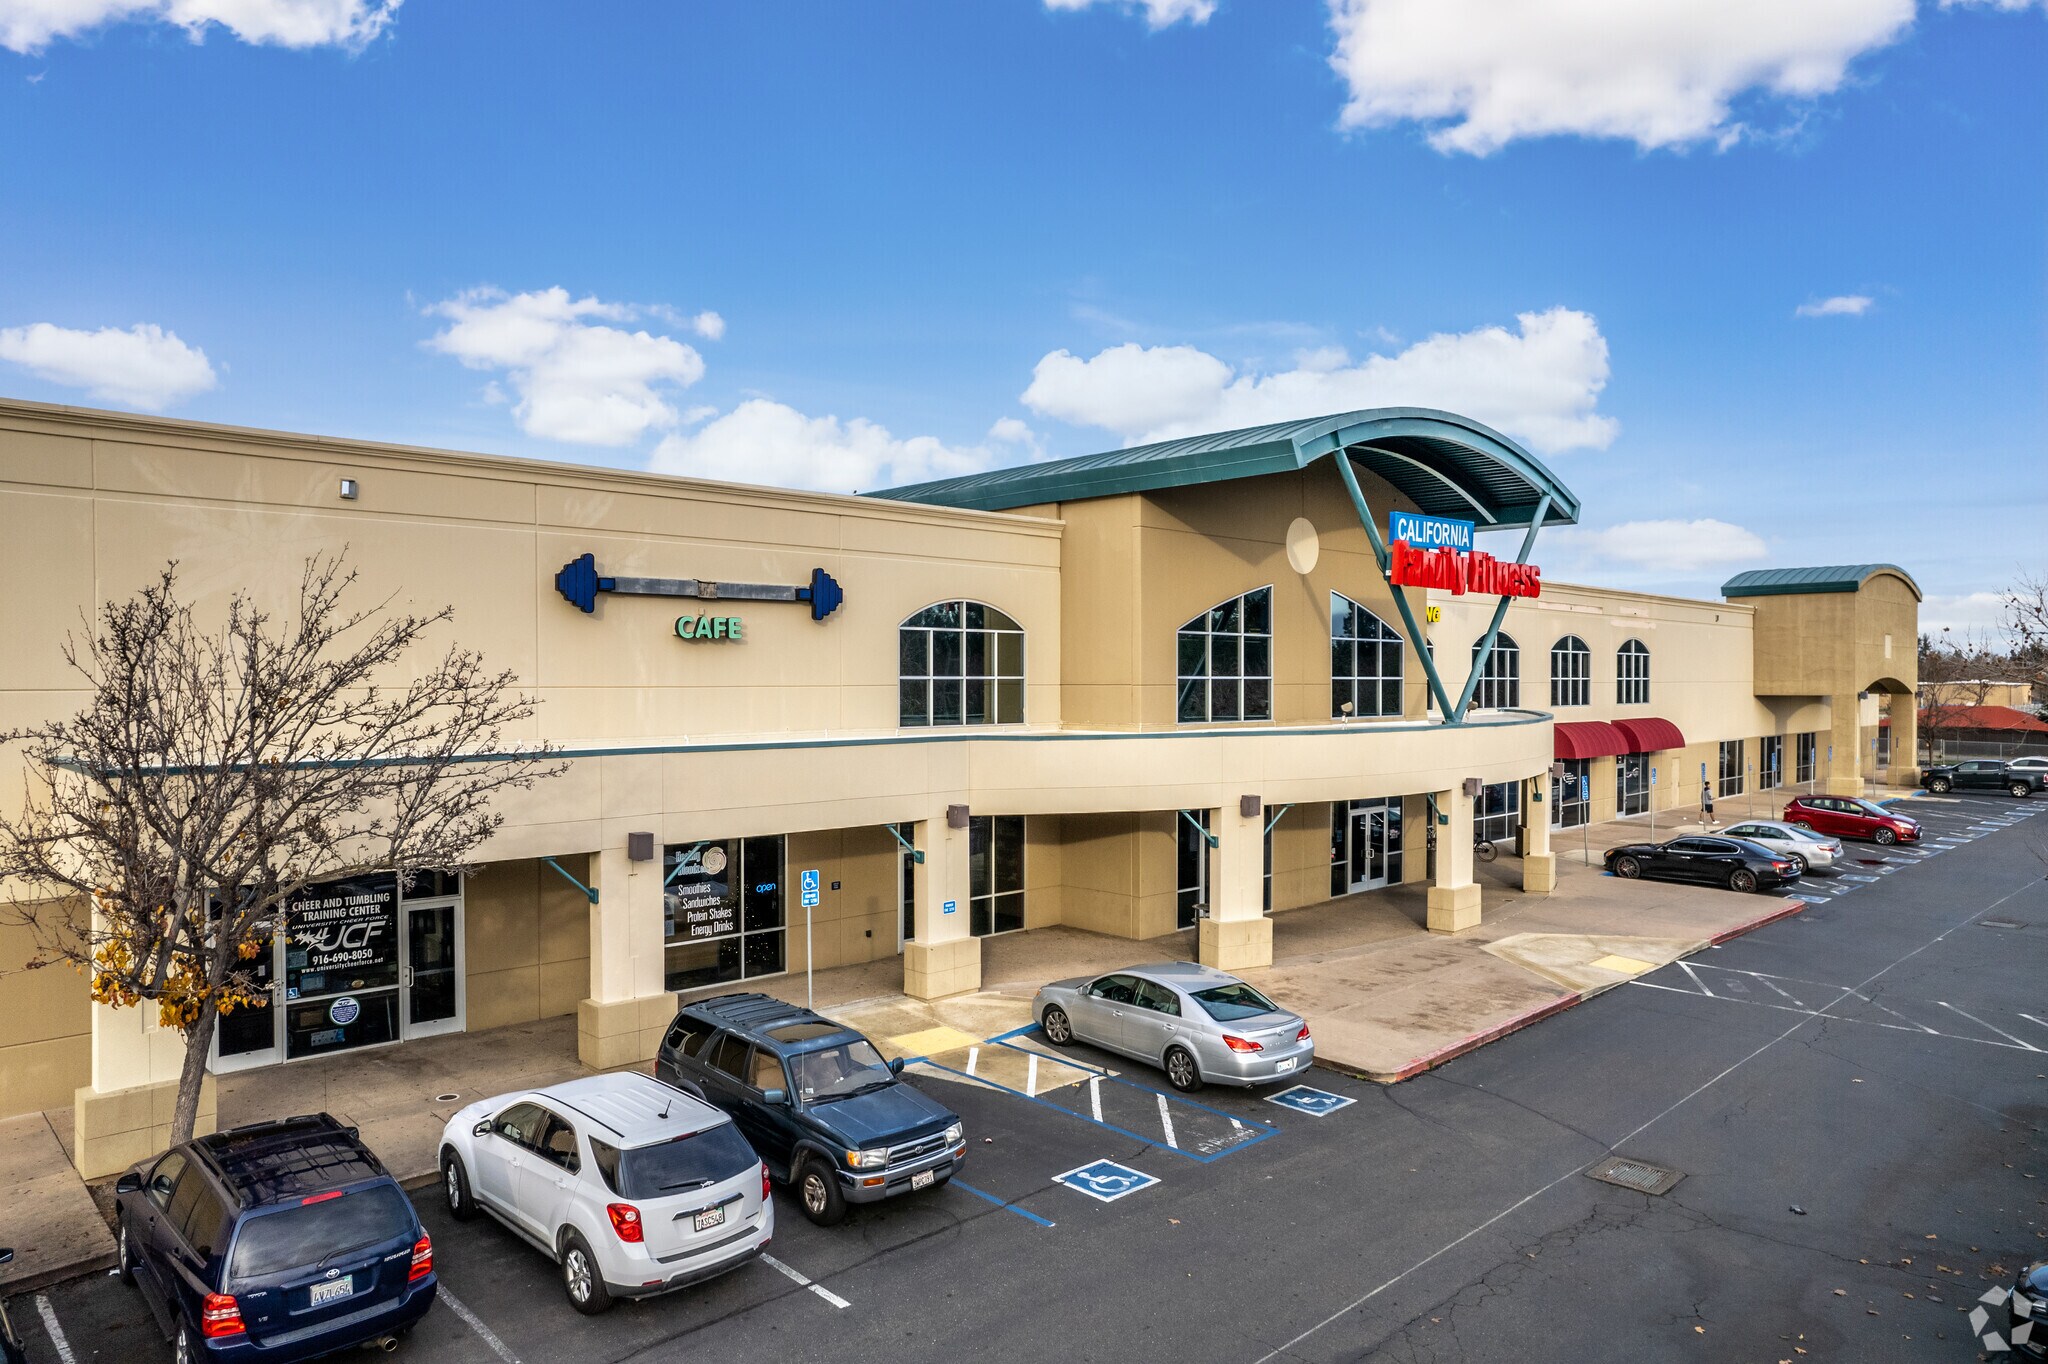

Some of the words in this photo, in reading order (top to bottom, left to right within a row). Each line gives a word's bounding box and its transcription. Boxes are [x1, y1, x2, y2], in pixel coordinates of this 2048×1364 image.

[1397, 518, 1470, 547] CALIFORNIA
[1390, 540, 1468, 596] Family
[1468, 551, 1541, 599] Fitness
[675, 616, 742, 639] CAFE
[678, 882, 711, 896] Smoothies
[755, 883, 777, 894] open
[292, 899, 320, 912] CHEER
[323, 897, 343, 909] AND
[344, 892, 390, 907] TUMBLING
[682, 895, 721, 910] Sandwiches
[303, 908, 346, 922] TRAINING
[349, 904, 381, 917] CENTER
[687, 909, 708, 923] Protein
[709, 907, 732, 920] Shakes
[292, 920, 338, 930] UNIVERSITY
[339, 917, 363, 925] CHEER
[691, 924, 713, 937] Energy
[713, 919, 734, 933] Drinks
[301, 957, 384, 974] www.universitycheerforce.net
[312, 948, 373, 966] 916-690-8050
